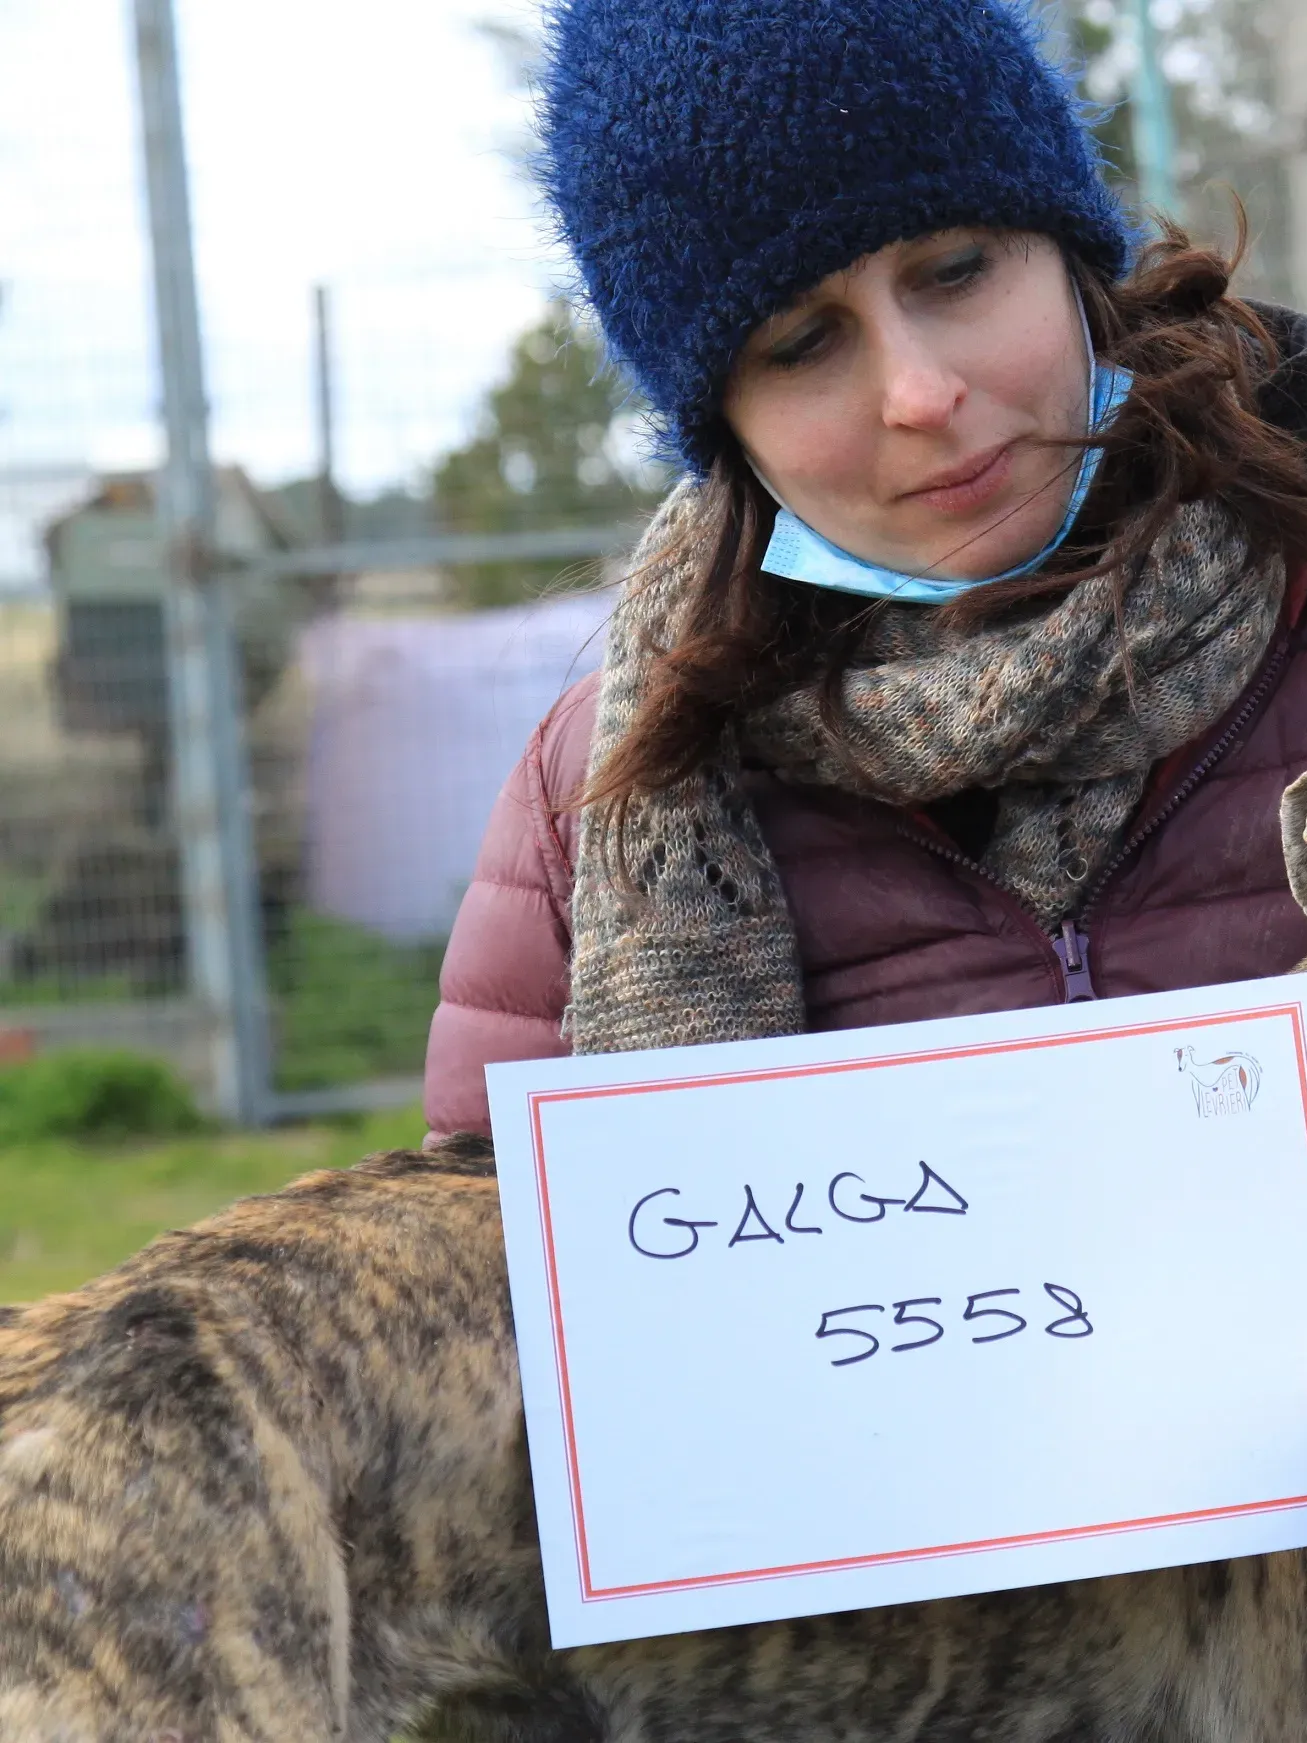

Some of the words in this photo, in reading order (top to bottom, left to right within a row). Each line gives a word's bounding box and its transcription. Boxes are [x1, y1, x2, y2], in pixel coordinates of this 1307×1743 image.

[1200, 1090, 1247, 1118] LEVRIERI
[1221, 1067, 1239, 1092] PET
[628, 1160, 969, 1260] GALGA
[815, 1282, 1094, 1367] 5558
